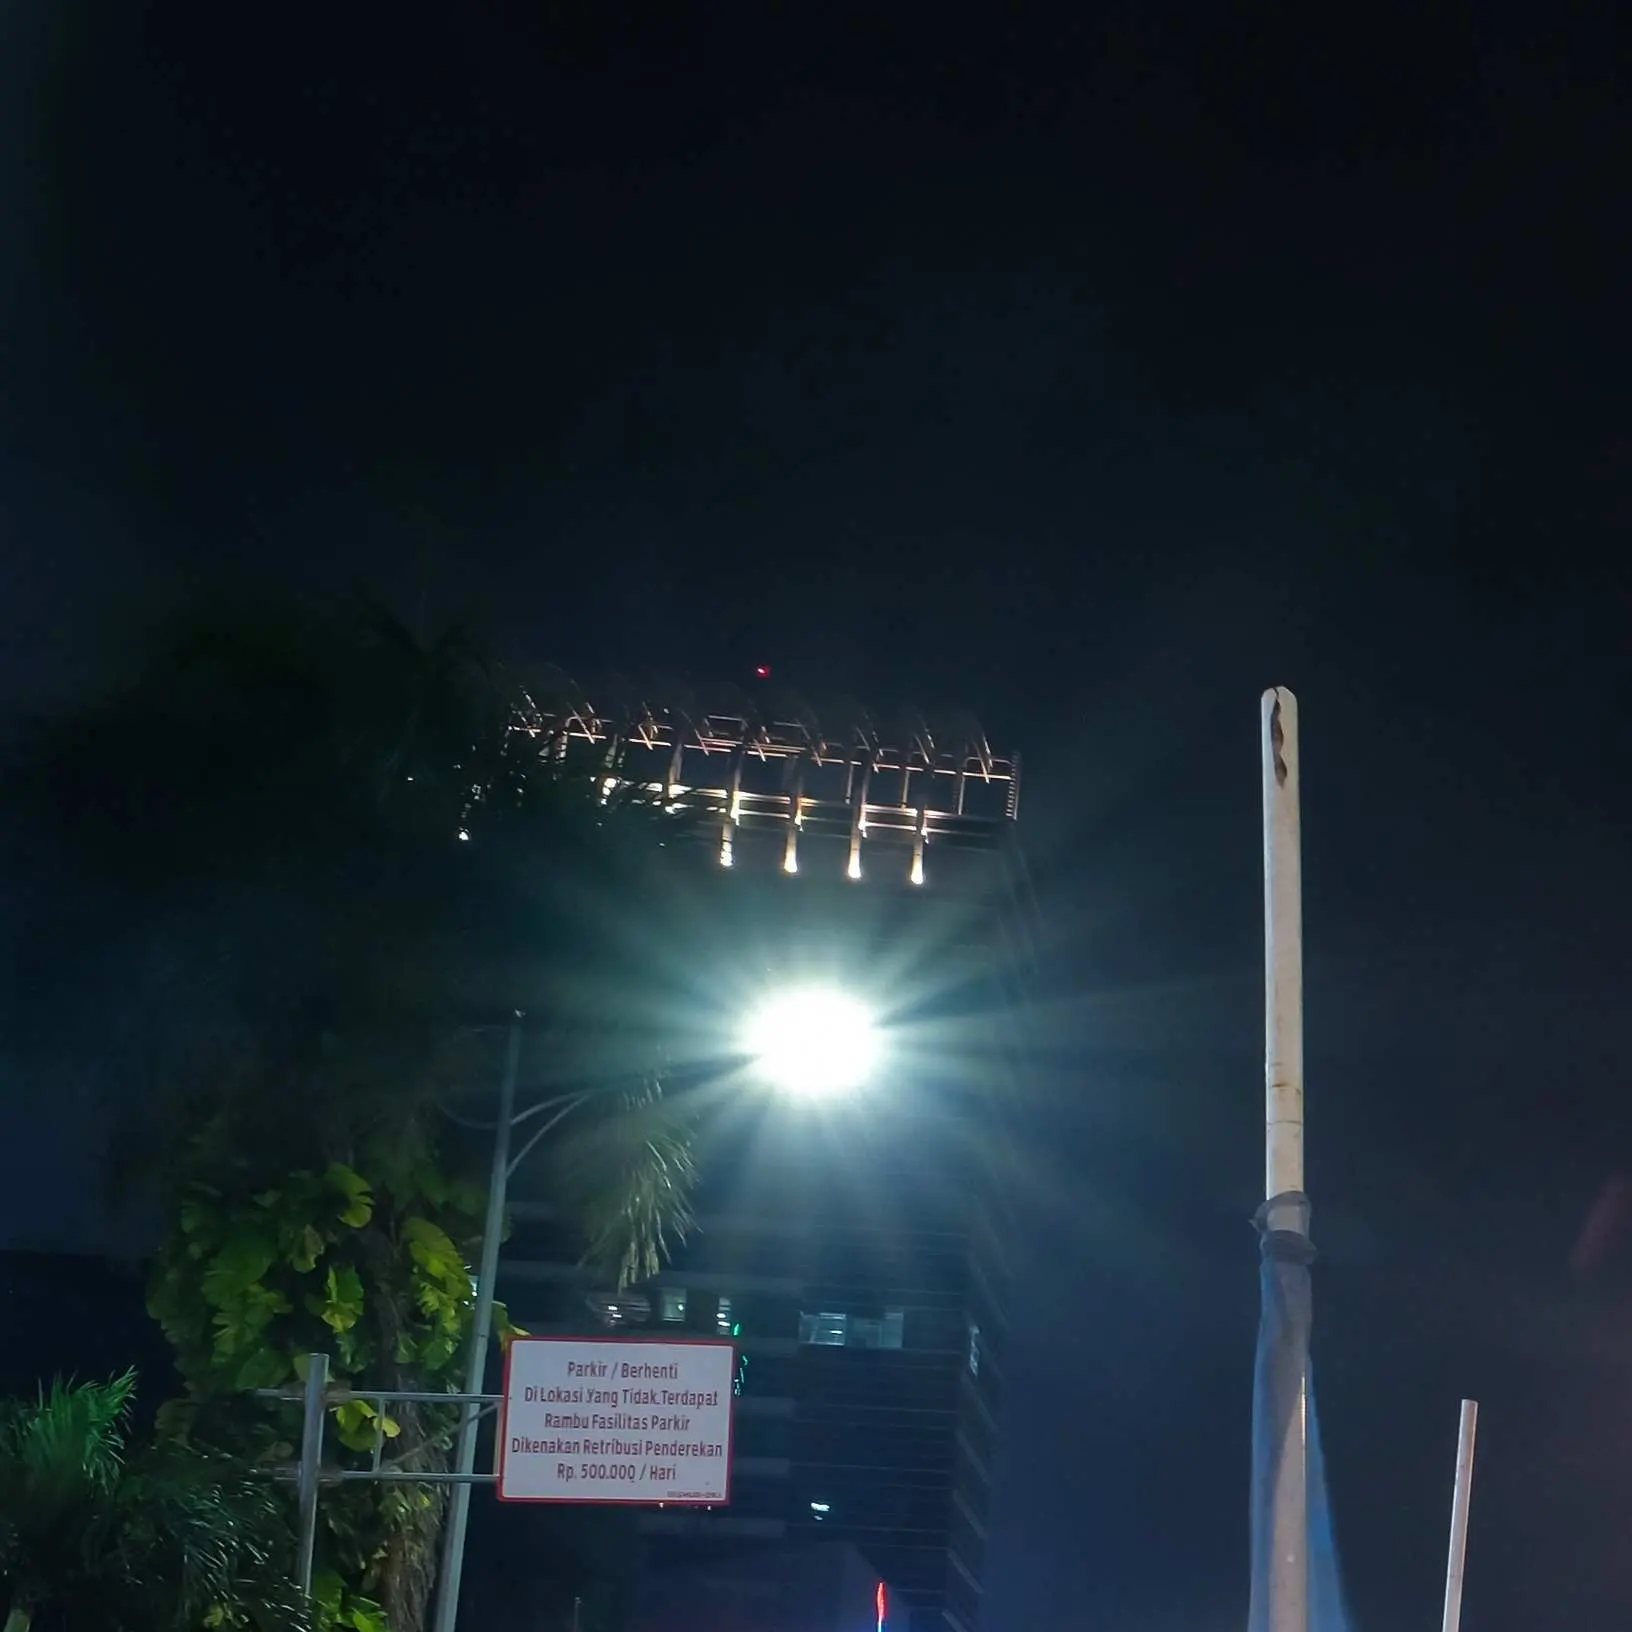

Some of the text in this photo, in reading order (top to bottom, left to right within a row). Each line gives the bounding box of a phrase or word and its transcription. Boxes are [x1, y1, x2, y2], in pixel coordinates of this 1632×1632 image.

[567, 1361, 678, 1380] Parkir / Berhenti
[525, 1386, 718, 1410] Di Lokasi Yang Tidak Terdapat
[545, 1413, 691, 1431] Rambu Fasilitas Parkir
[511, 1437, 723, 1457] Dikenakan Retribusi Penderekan
[581, 1464, 636, 1480] 500.000
[650, 1464, 677, 1480] Hari
